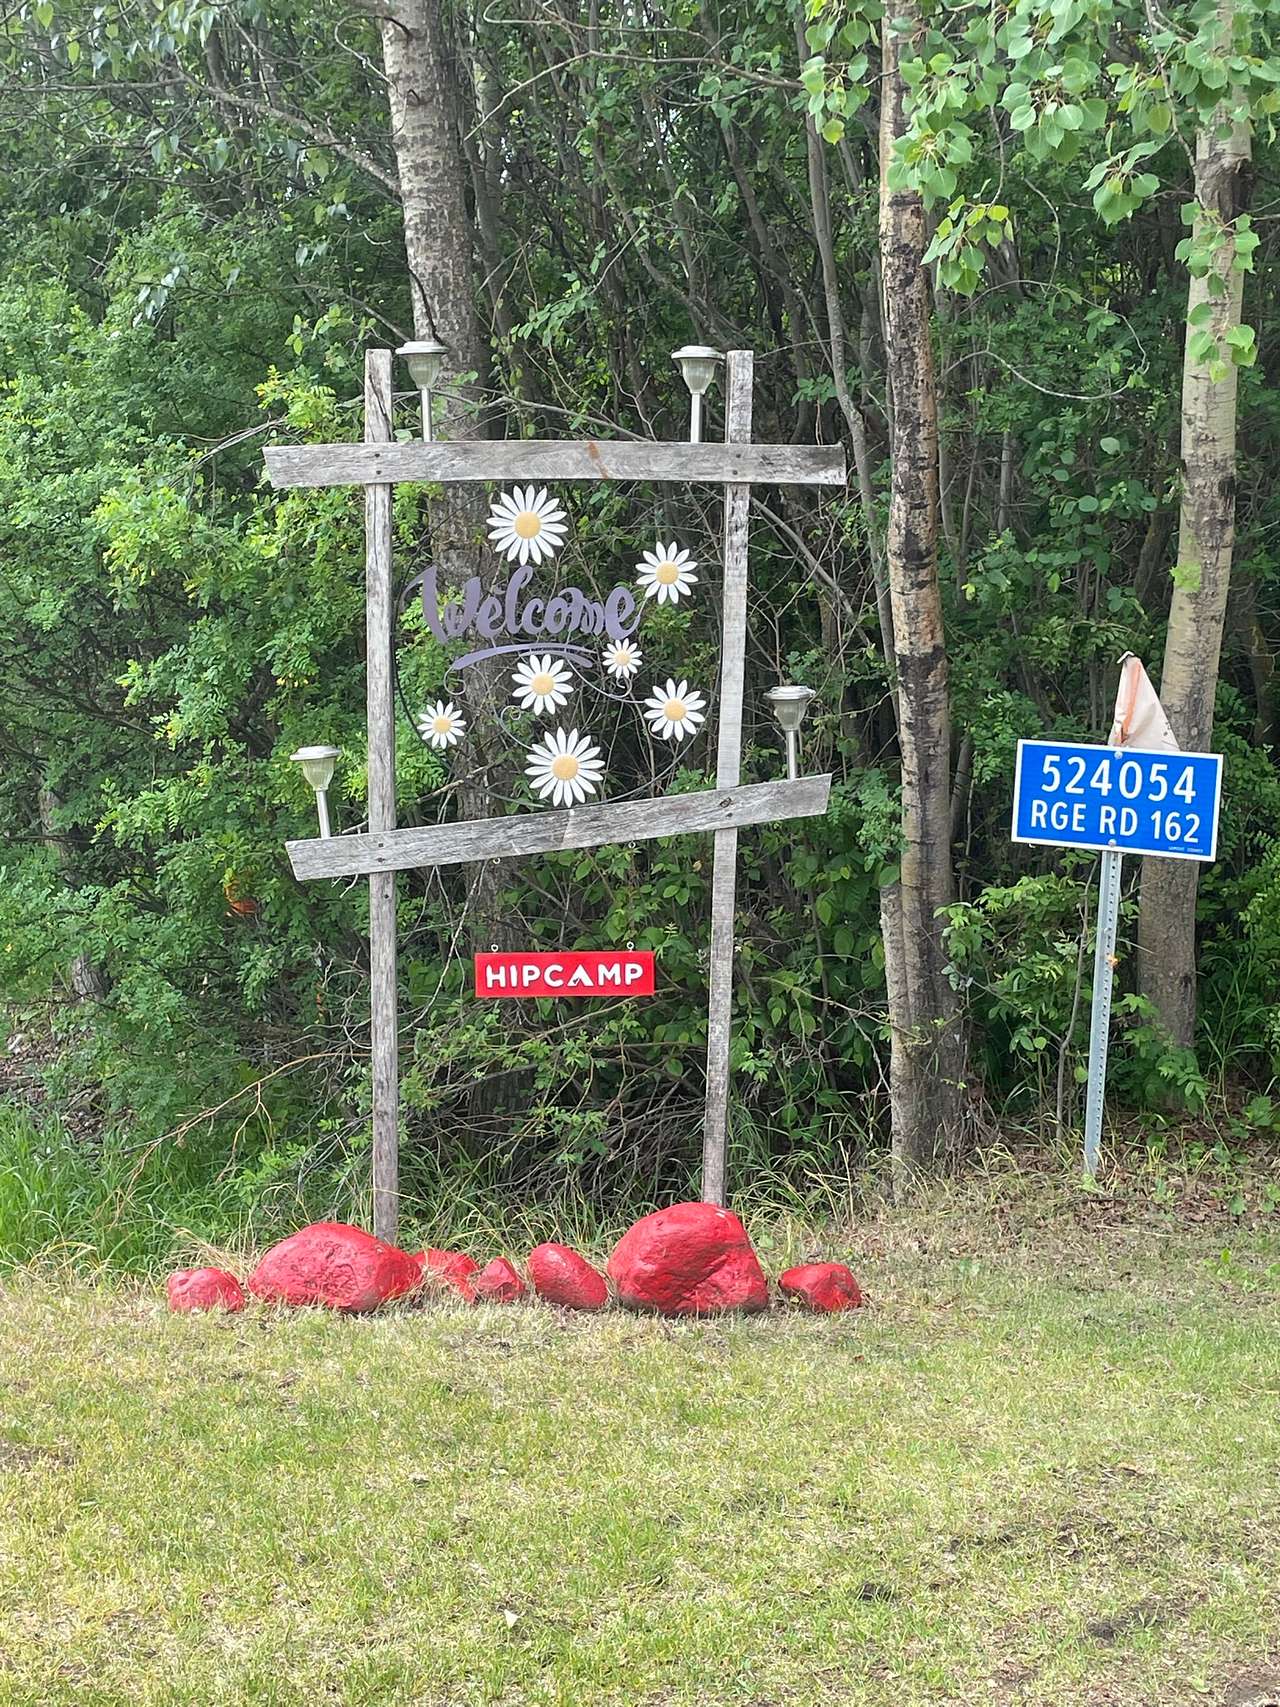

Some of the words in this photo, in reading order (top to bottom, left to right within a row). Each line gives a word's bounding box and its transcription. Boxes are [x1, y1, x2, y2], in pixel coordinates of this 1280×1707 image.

[401, 565, 641, 644] Welcome
[1041, 754, 1197, 805] 524054
[1030, 799, 1087, 832] RGE
[1099, 805, 1139, 837] RD
[1150, 810, 1201, 843] 162
[486, 963, 644, 988] HIPCAMP
